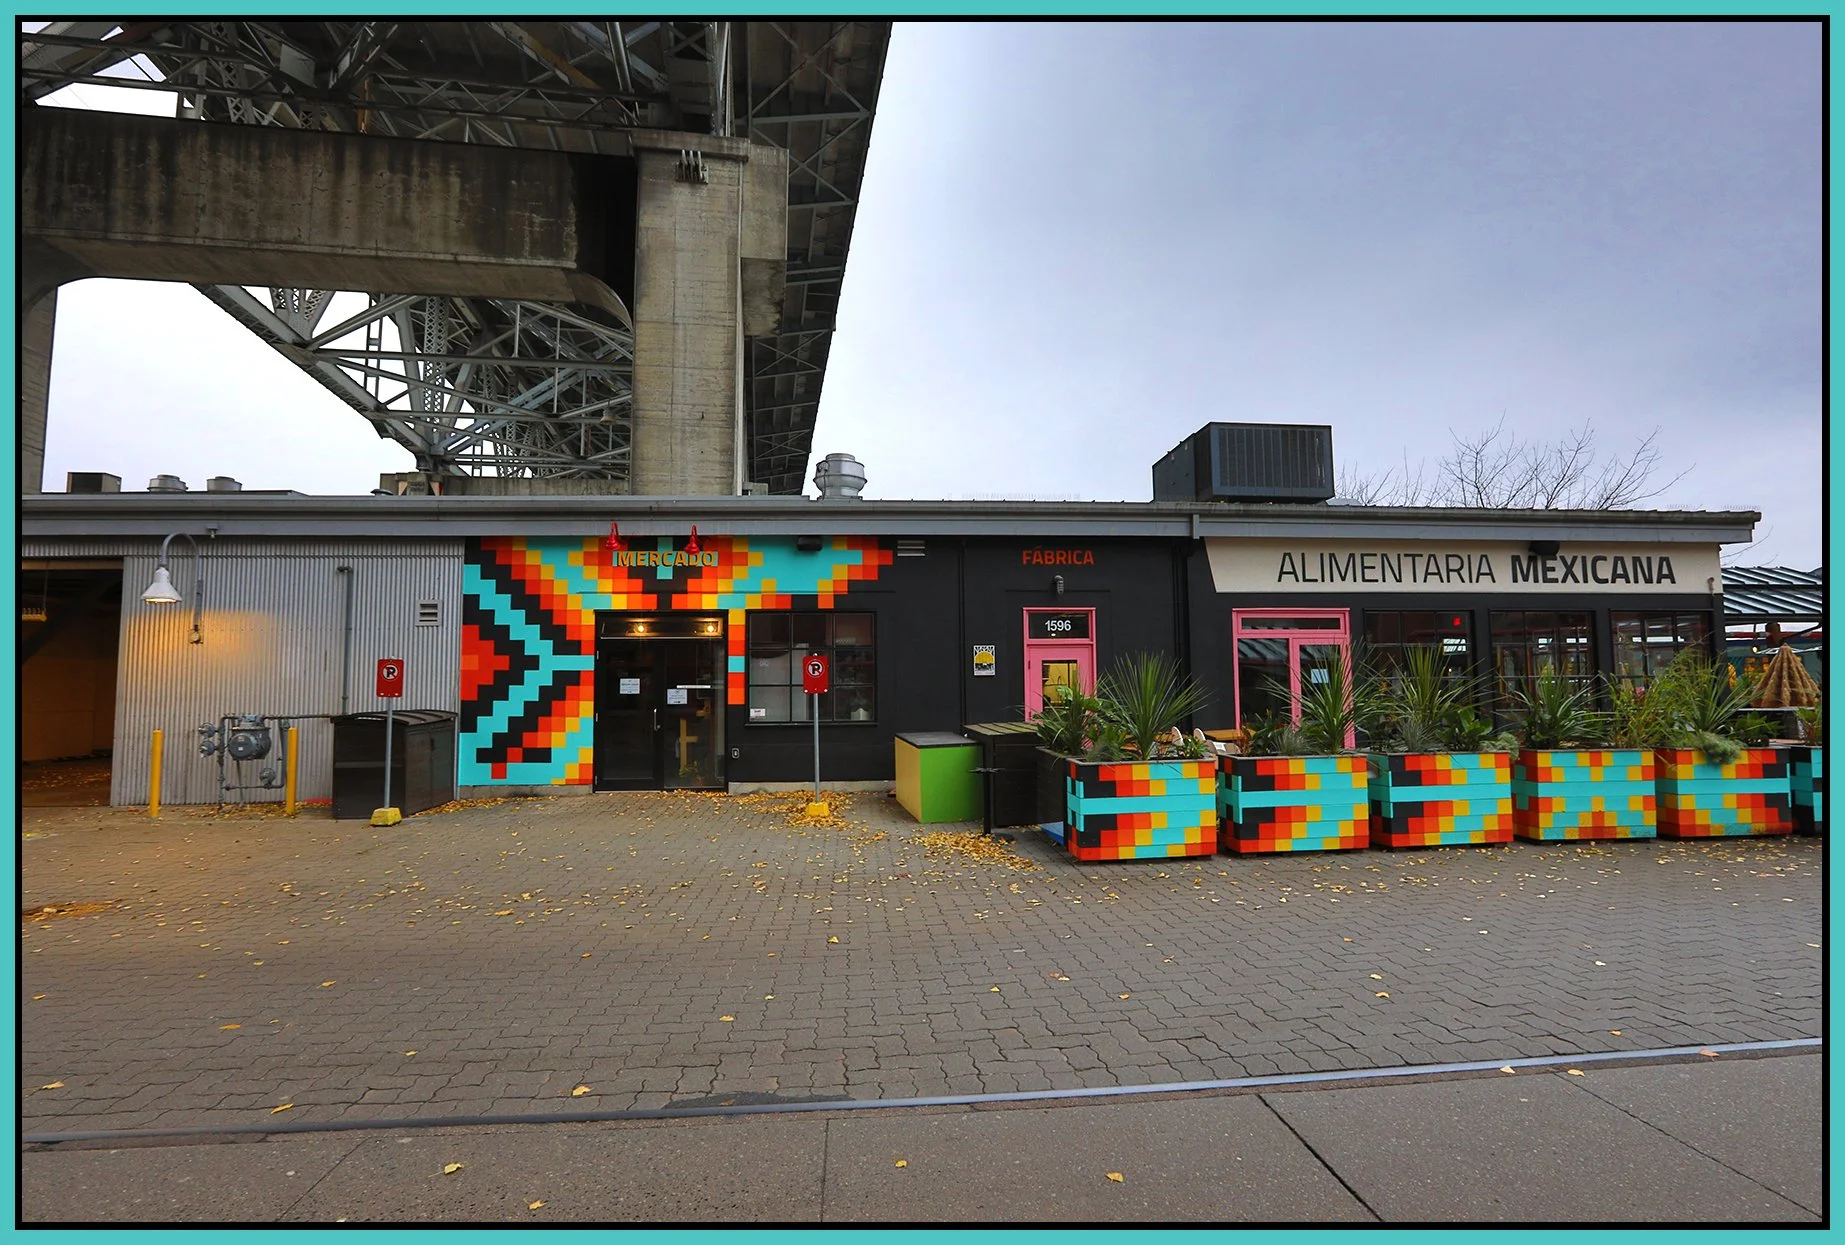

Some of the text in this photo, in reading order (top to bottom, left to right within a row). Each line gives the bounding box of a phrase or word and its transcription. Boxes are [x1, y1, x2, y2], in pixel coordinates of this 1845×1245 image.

[617, 551, 715, 567] MERCADO
[1022, 546, 1095, 565] FÁBRICA
[1277, 552, 1676, 585] ALIMENTARIA MEXICANA
[1044, 619, 1072, 632] 1596
